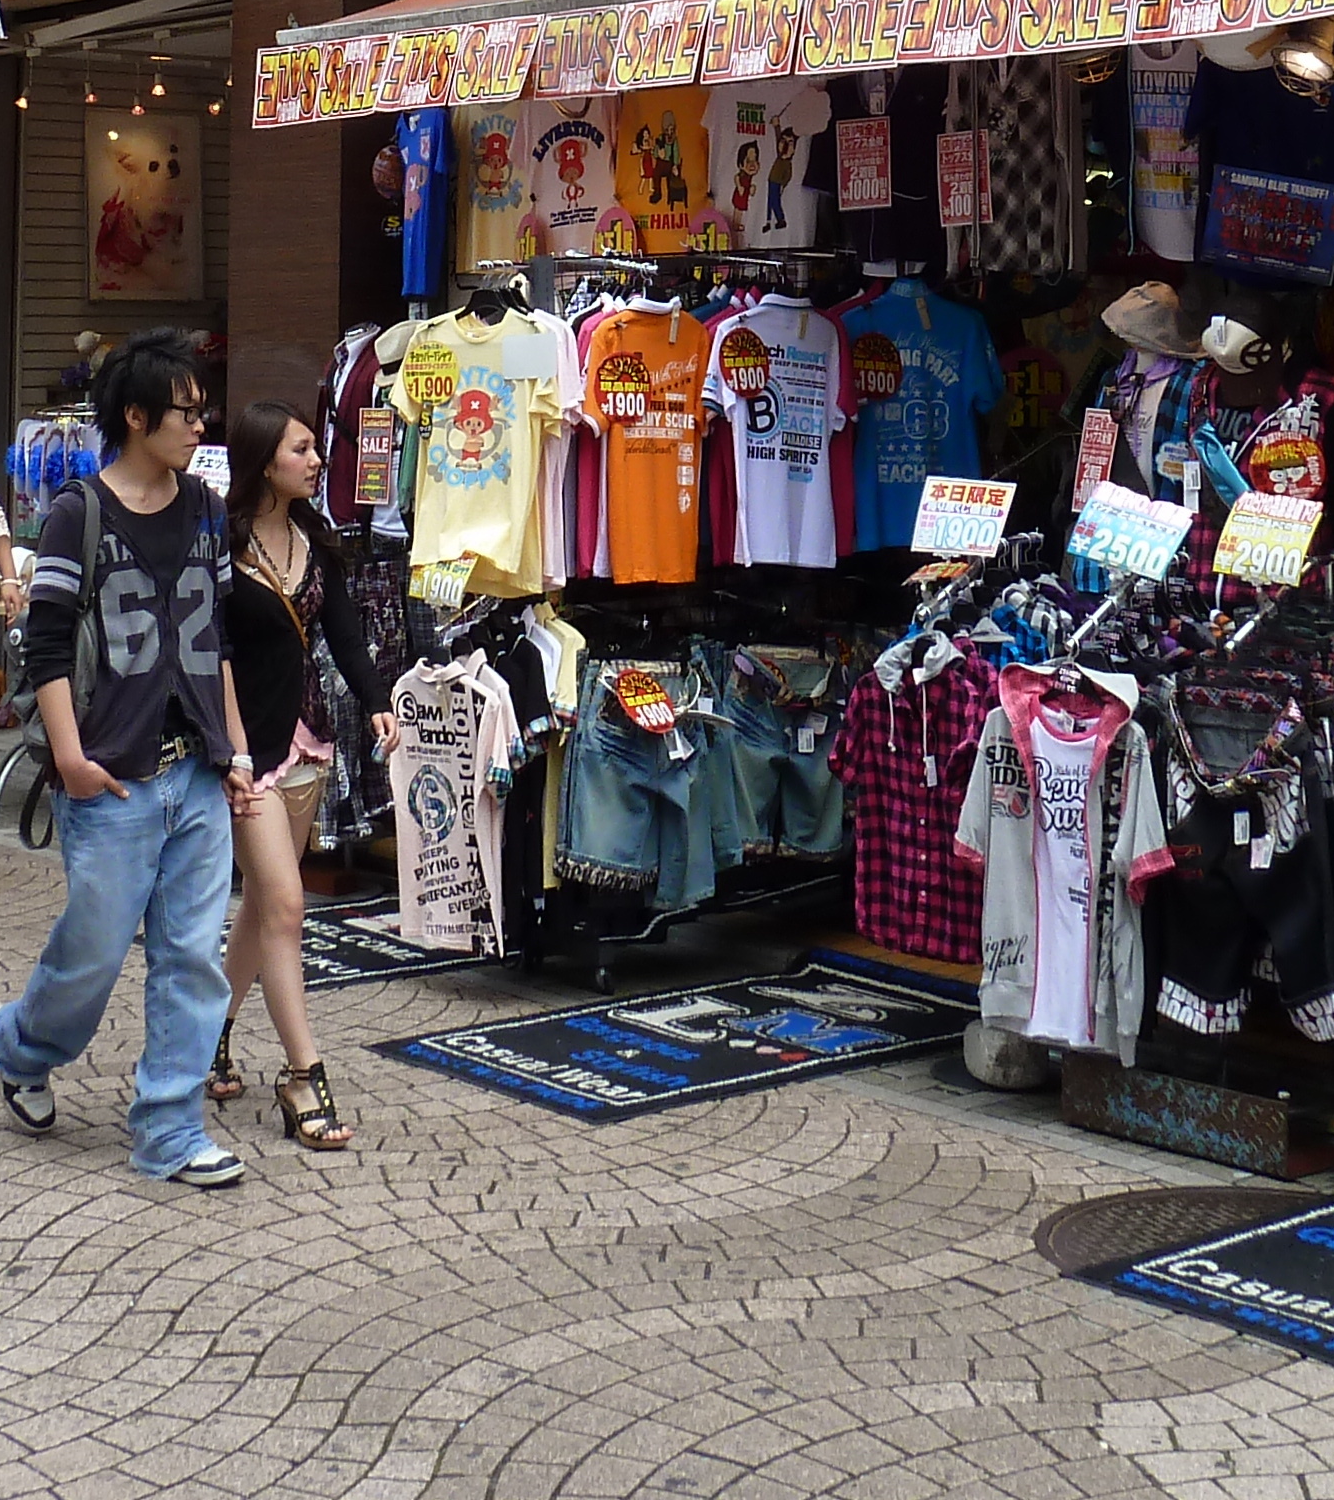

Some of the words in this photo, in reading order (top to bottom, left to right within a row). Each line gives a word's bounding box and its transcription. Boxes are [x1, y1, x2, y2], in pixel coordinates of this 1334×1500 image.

[539, 10, 619, 91] SALE
[619, 4, 707, 85] SALE
[455, 17, 539, 101] SALE
[408, 376, 453, 398] ¥1,900
[727, 366, 765, 390] ¥1900
[855, 370, 895, 393] ¥1900
[601, 392, 645, 417] ¥1900
[362, 437, 389, 453] SALE
[782, 433, 821, 448] PARADISE
[747, 446, 775, 460] HIGH
[779, 449, 819, 465] SPIRITS
[930, 483, 1006, 506] 本日限定
[1071, 528, 1168, 573] ¥2500
[1216, 541, 1301, 584] ¥2900
[100, 566, 219, 678] 62
[446, 1036, 568, 1073] Casual
[551, 1067, 647, 1099] Wear
